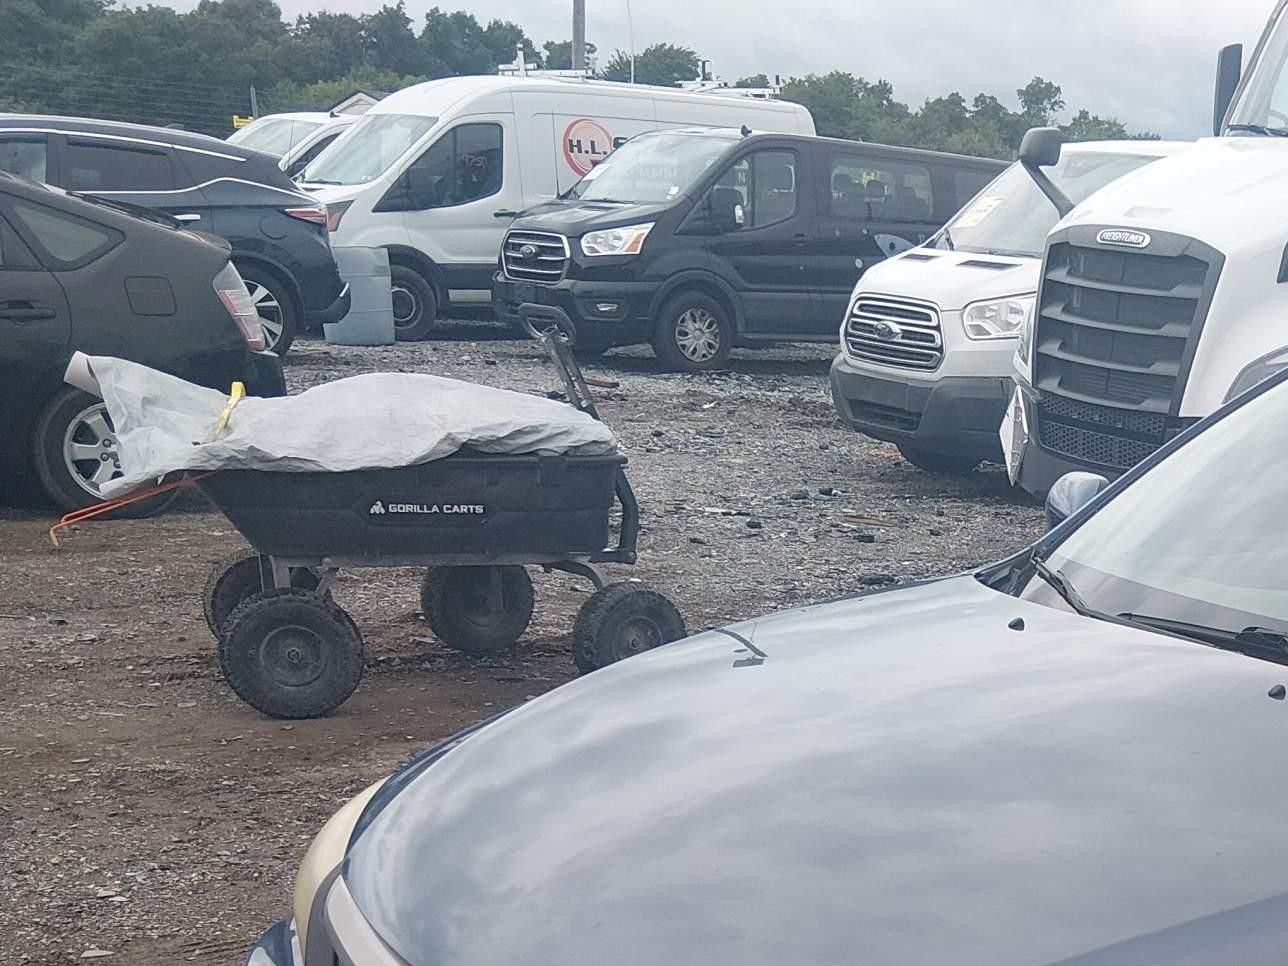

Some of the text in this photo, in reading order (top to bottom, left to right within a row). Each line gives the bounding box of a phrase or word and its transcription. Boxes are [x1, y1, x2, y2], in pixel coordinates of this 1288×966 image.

[568, 139, 608, 155] H.L.
[388, 503, 485, 514] GORILLA CARTS
